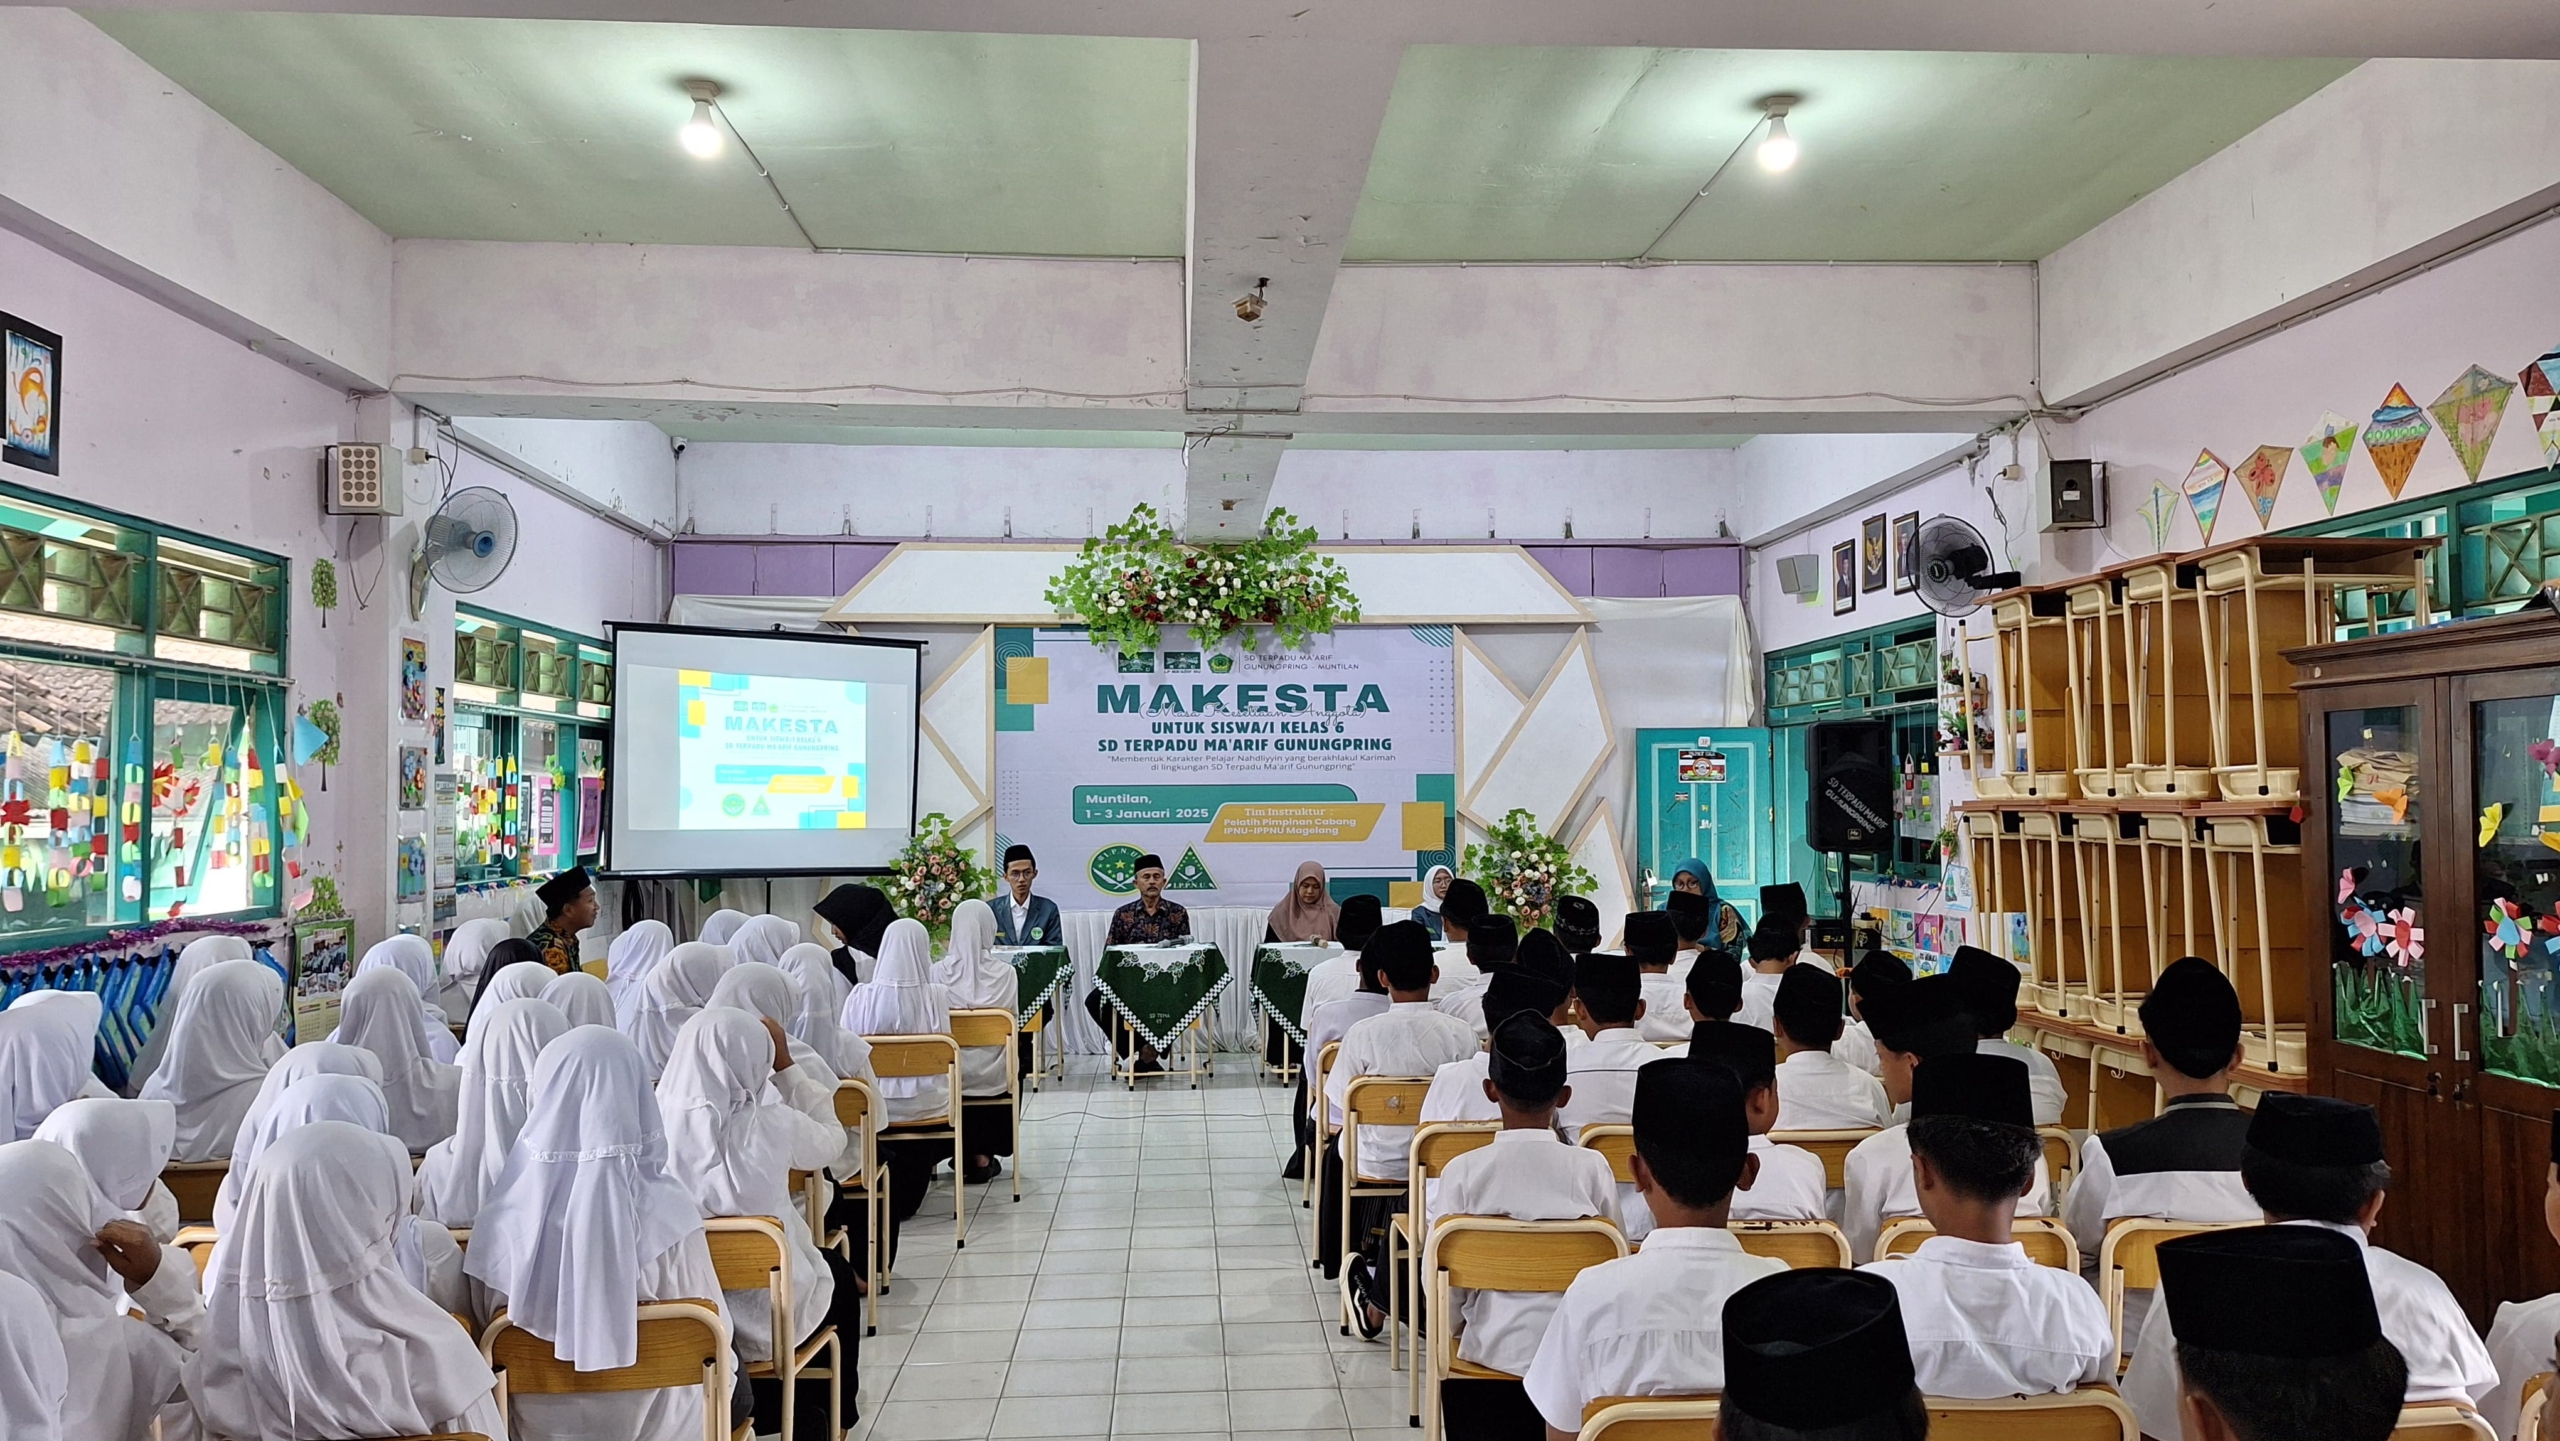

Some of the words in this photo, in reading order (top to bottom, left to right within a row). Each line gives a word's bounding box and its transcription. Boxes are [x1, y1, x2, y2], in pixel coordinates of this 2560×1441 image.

[1097, 684, 1391, 713] MAKESTA
[725, 716, 838, 734] MAKESTA
[1151, 721, 1205, 734] UNTUK
[1210, 721, 1275, 734] SISWA/I
[1280, 721, 1329, 734] KELAS
[1335, 721, 1345, 734] 6
[1098, 739, 1118, 752] SD
[1124, 739, 1198, 752] TERPADU
[1204, 739, 1269, 752] MA'ARIF
[1274, 738, 1392, 751] GUNUNGPRING
[1206, 755, 1235, 763] Pelajar
[1238, 755, 1282, 763] Nahdliyyin
[1161, 763, 1208, 772] lingkungan
[1225, 763, 1262, 772] Terpadu
[1296, 763, 1356, 771] Gunungpring"
[1085, 794, 1152, 804] Muntilan,
[1827, 777, 1839, 788] SD
[1838, 784, 1868, 812] TERPADU
[1085, 809, 1091, 818] 1
[1105, 809, 1113, 818] 3
[1116, 808, 1170, 818] Januari
[1176, 808, 1209, 818] 2025
[1244, 808, 1265, 816] Tim
[1268, 808, 1326, 816] Instruktur
[1224, 818, 1260, 826] Pelatih
[1262, 818, 1312, 828] Pimpinan
[1315, 818, 1356, 827] Cabang
[1286, 827, 1339, 836] Magelang
